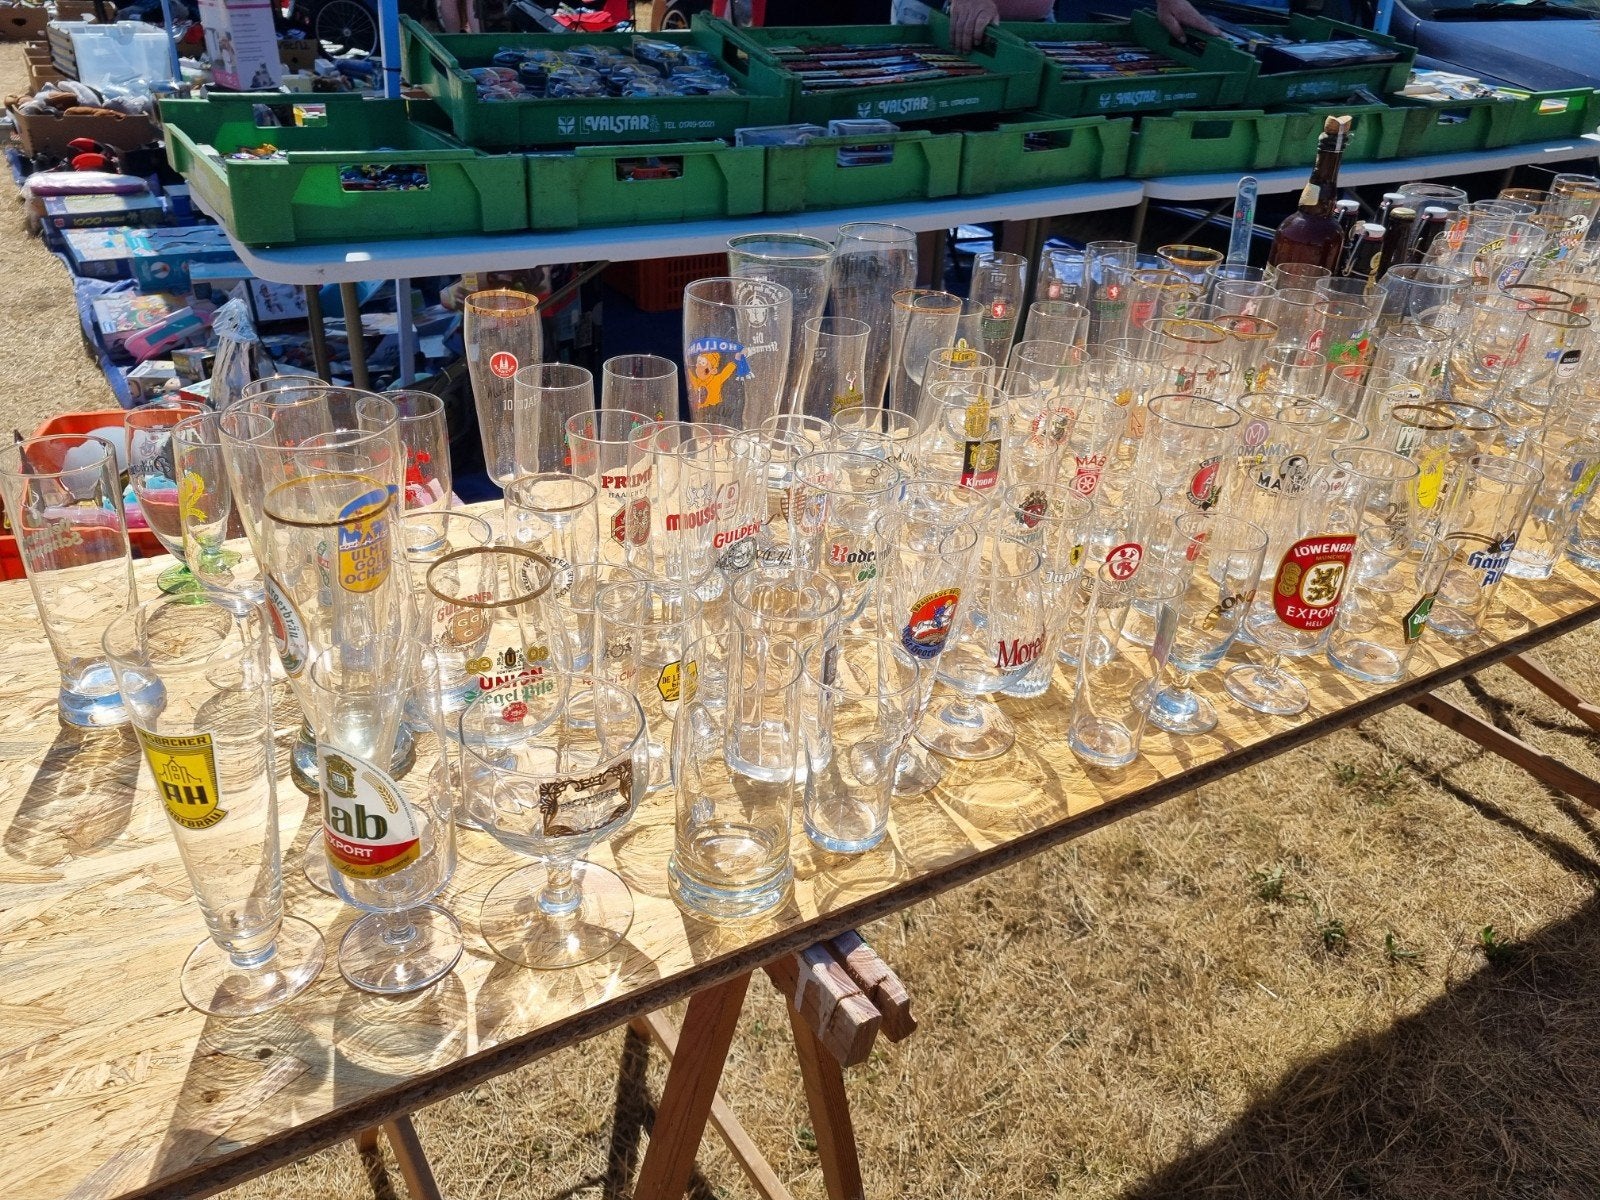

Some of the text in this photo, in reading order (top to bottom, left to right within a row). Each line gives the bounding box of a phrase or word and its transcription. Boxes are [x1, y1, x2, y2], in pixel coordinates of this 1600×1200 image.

[879, 96, 929, 114] VALSTAR
[585, 114, 650, 133] VALSTAR
[664, 121, 676, 129] TEL
[480, 667, 544, 690] UNION
[162, 781, 209, 805] AH
